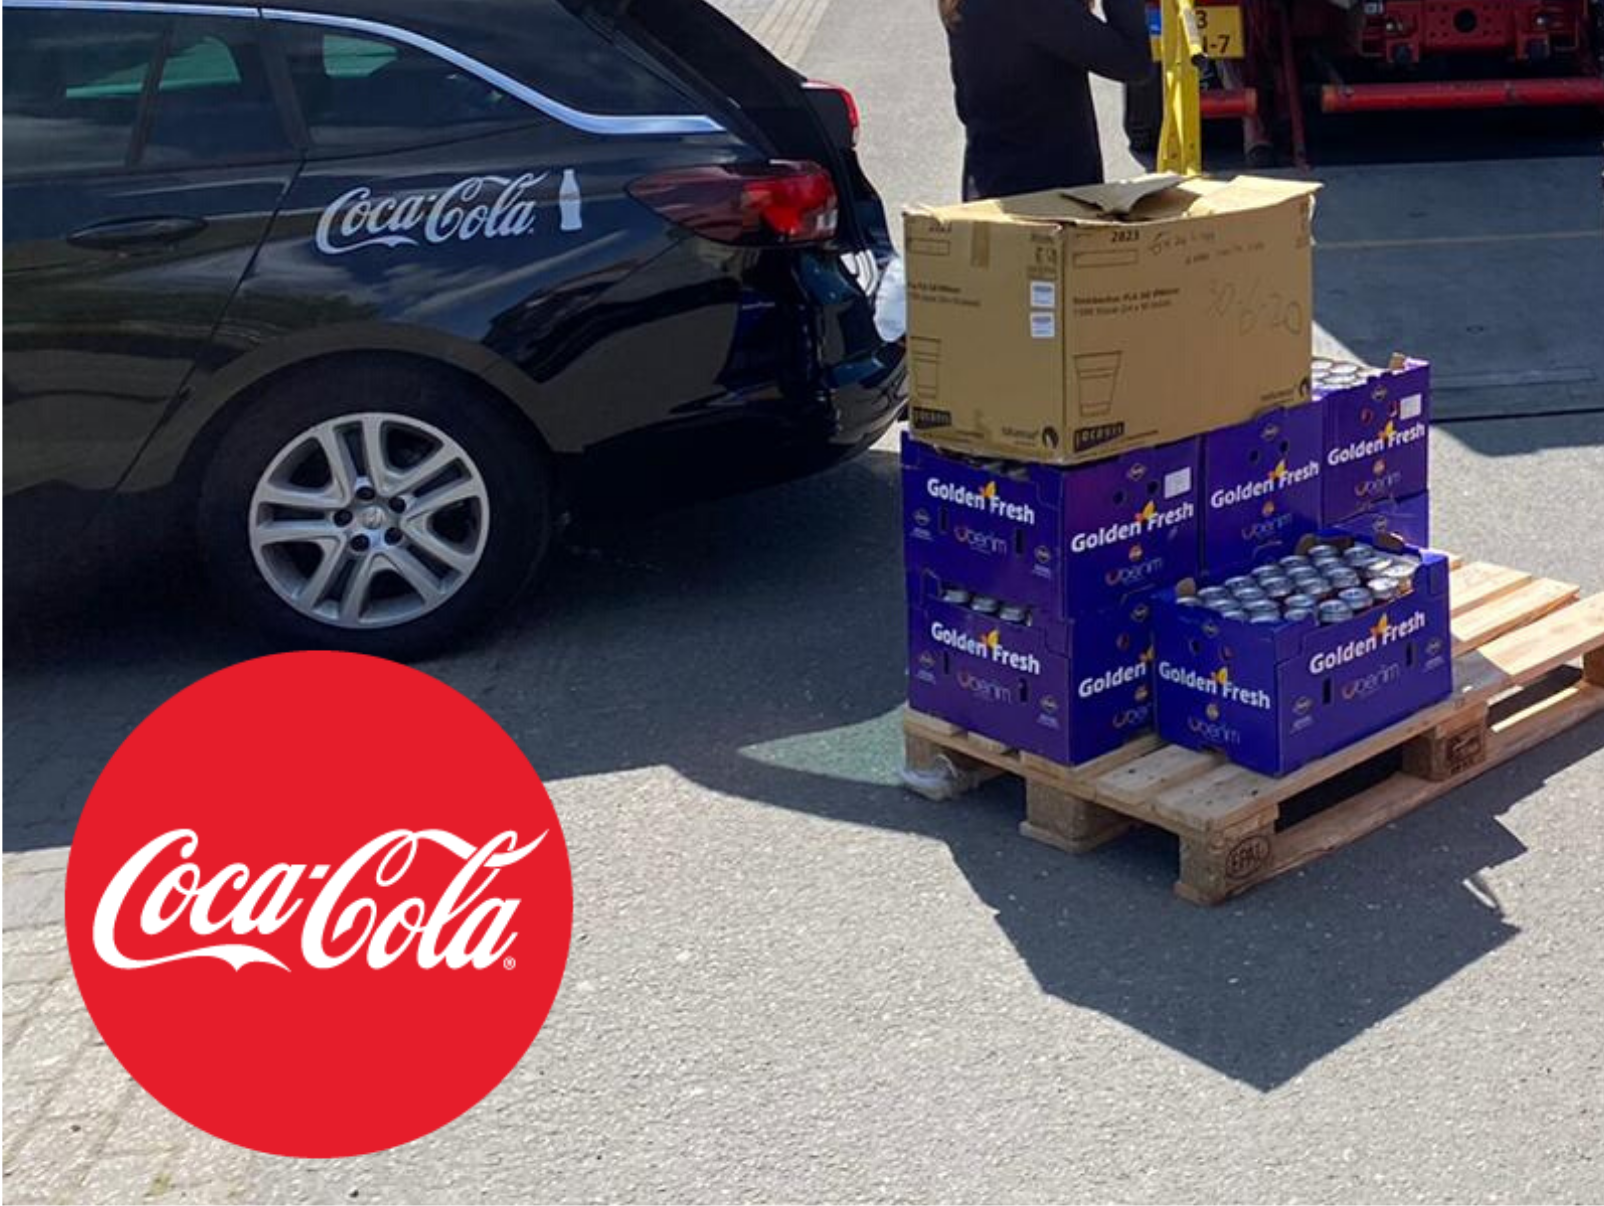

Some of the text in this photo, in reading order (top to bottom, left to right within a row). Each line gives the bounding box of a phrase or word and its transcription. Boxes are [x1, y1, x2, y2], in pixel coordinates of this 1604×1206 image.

[316, 172, 549, 255] Coca-Cola
[1328, 422, 1425, 466] Golden Fresh
[927, 478, 1036, 525] Golden Fresh
[1210, 460, 1320, 509] Golden Fresh
[1071, 502, 1194, 553] Golden Fresh
[931, 622, 1041, 675] Golden Fresh
[1309, 611, 1426, 675] Golden Fresh
[1078, 662, 1147, 698] Golden
[1158, 661, 1272, 711] Golden Fresh
